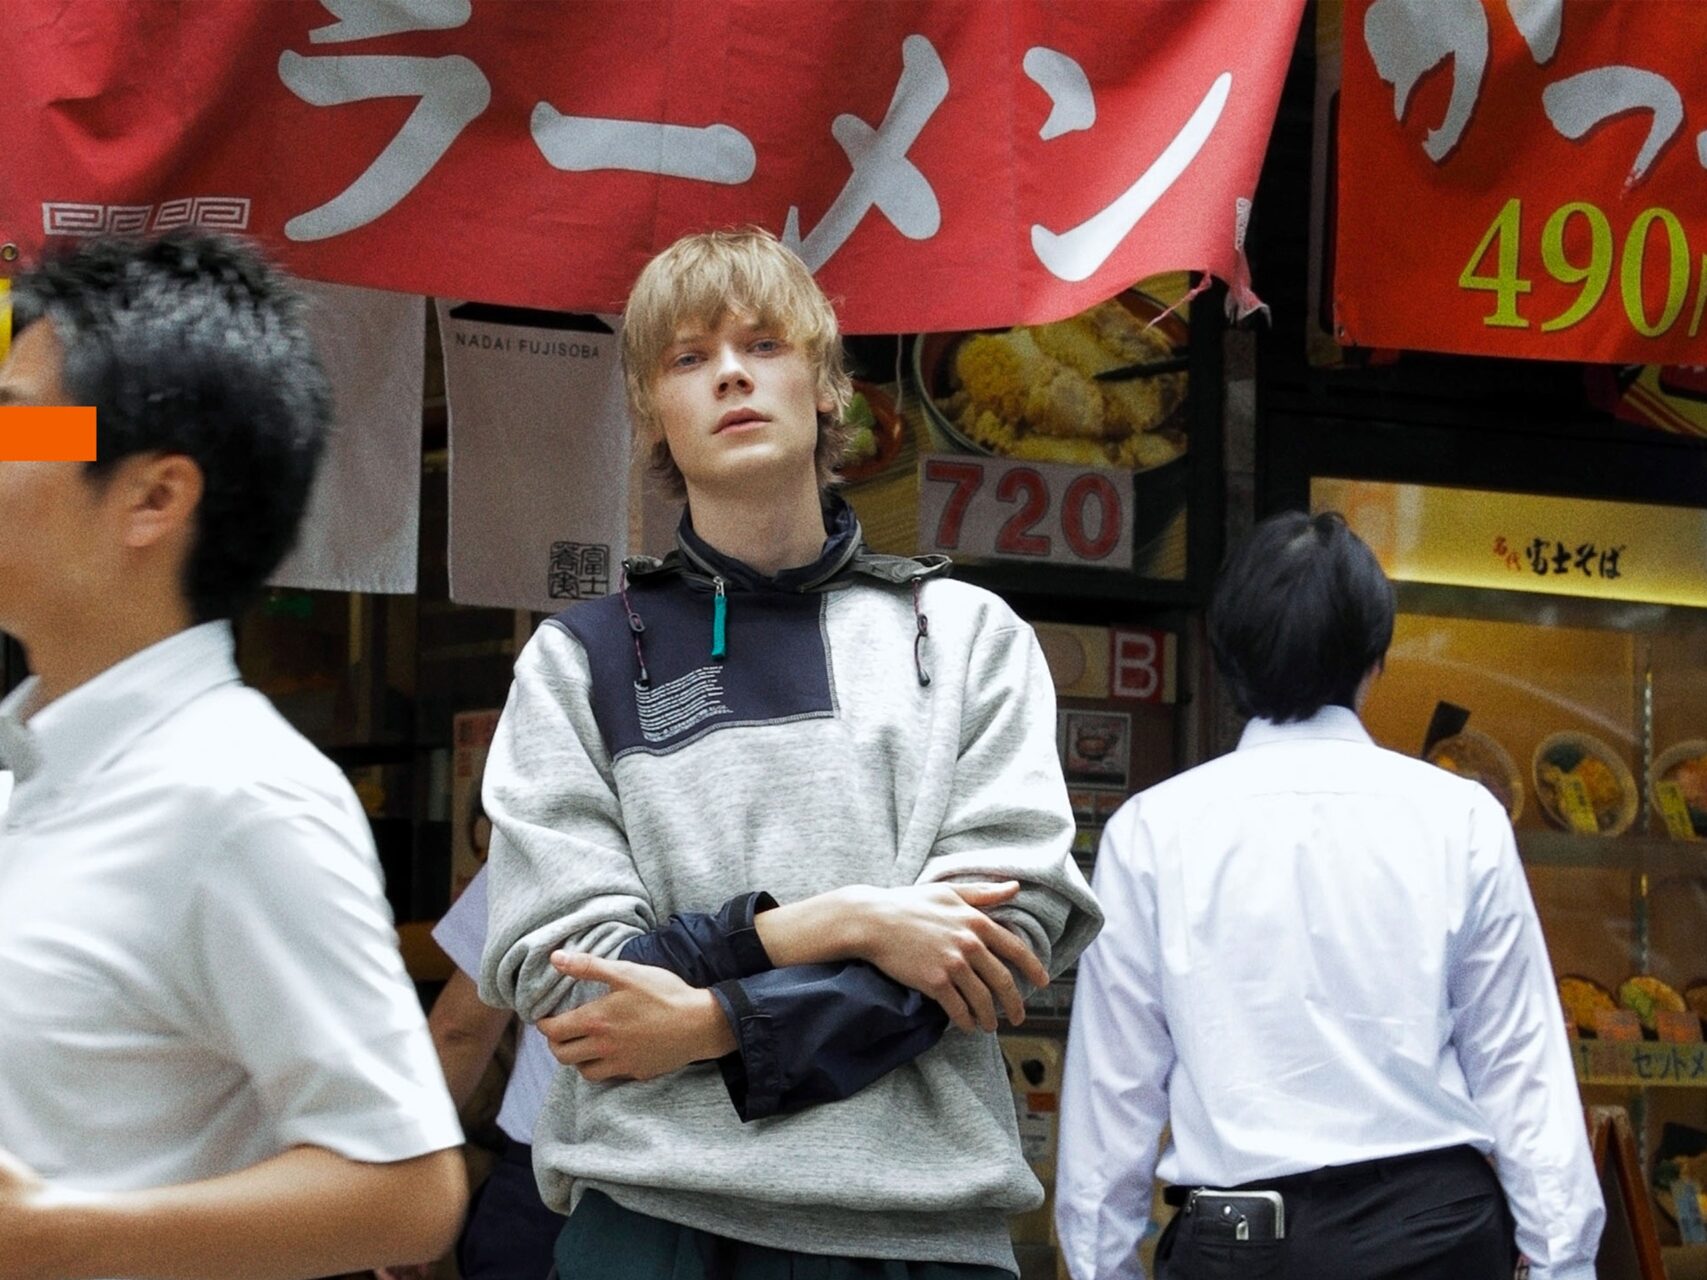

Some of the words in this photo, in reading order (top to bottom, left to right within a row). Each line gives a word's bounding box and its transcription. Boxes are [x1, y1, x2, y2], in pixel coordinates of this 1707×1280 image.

[278, 0, 1233, 282] ラーメン
[1458, 197, 1707, 339] 490
[455, 331, 511, 351] NADAI
[518, 339, 600, 359] FUJISOBA
[924, 460, 1123, 561] 720
[1526, 537, 1627, 580] 富士そば
[1112, 631, 1159, 699] B
